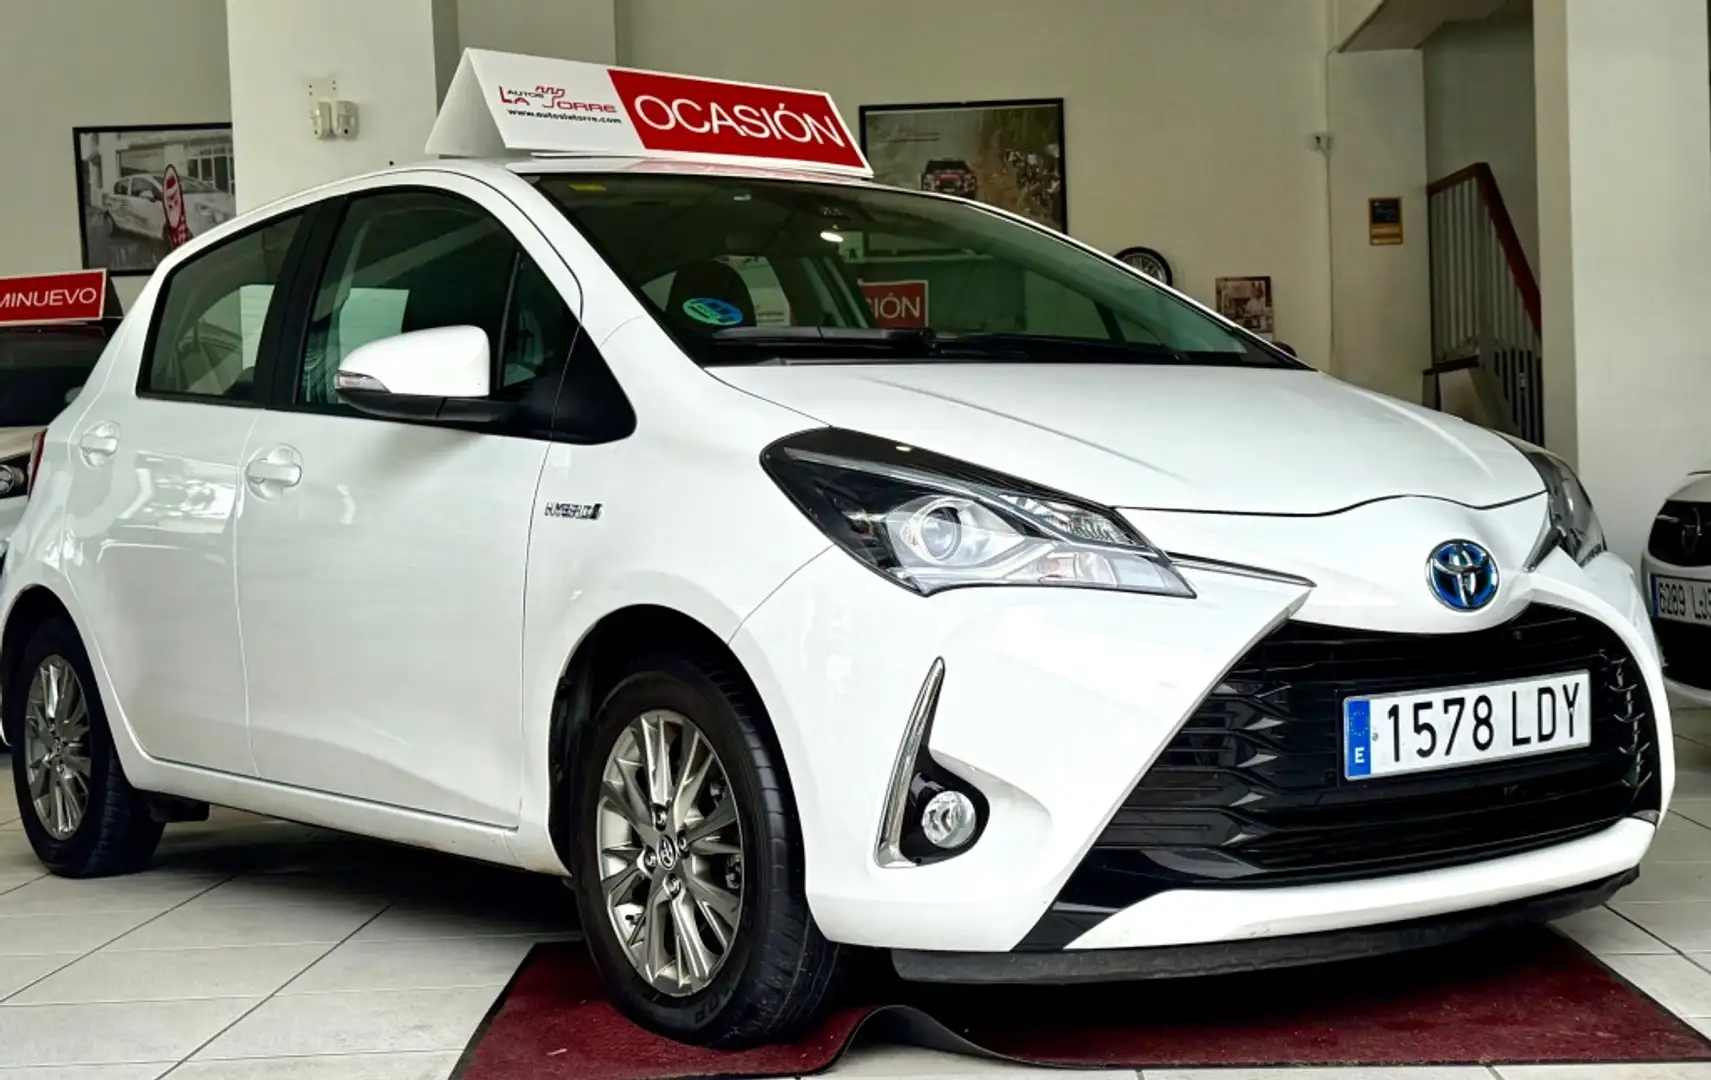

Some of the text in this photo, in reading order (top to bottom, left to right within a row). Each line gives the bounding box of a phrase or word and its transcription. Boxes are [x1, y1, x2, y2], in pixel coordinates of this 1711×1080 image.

[498, 85, 617, 113] LA TORRE
[507, 89, 544, 99] AUTOS
[507, 108, 622, 125] www.autoslatorre.com
[633, 94, 846, 148] OCASIÓN
[1658, 582, 1686, 616] 6289
[1387, 682, 1580, 763] 1578 LDY
[1354, 747, 1365, 764] E
